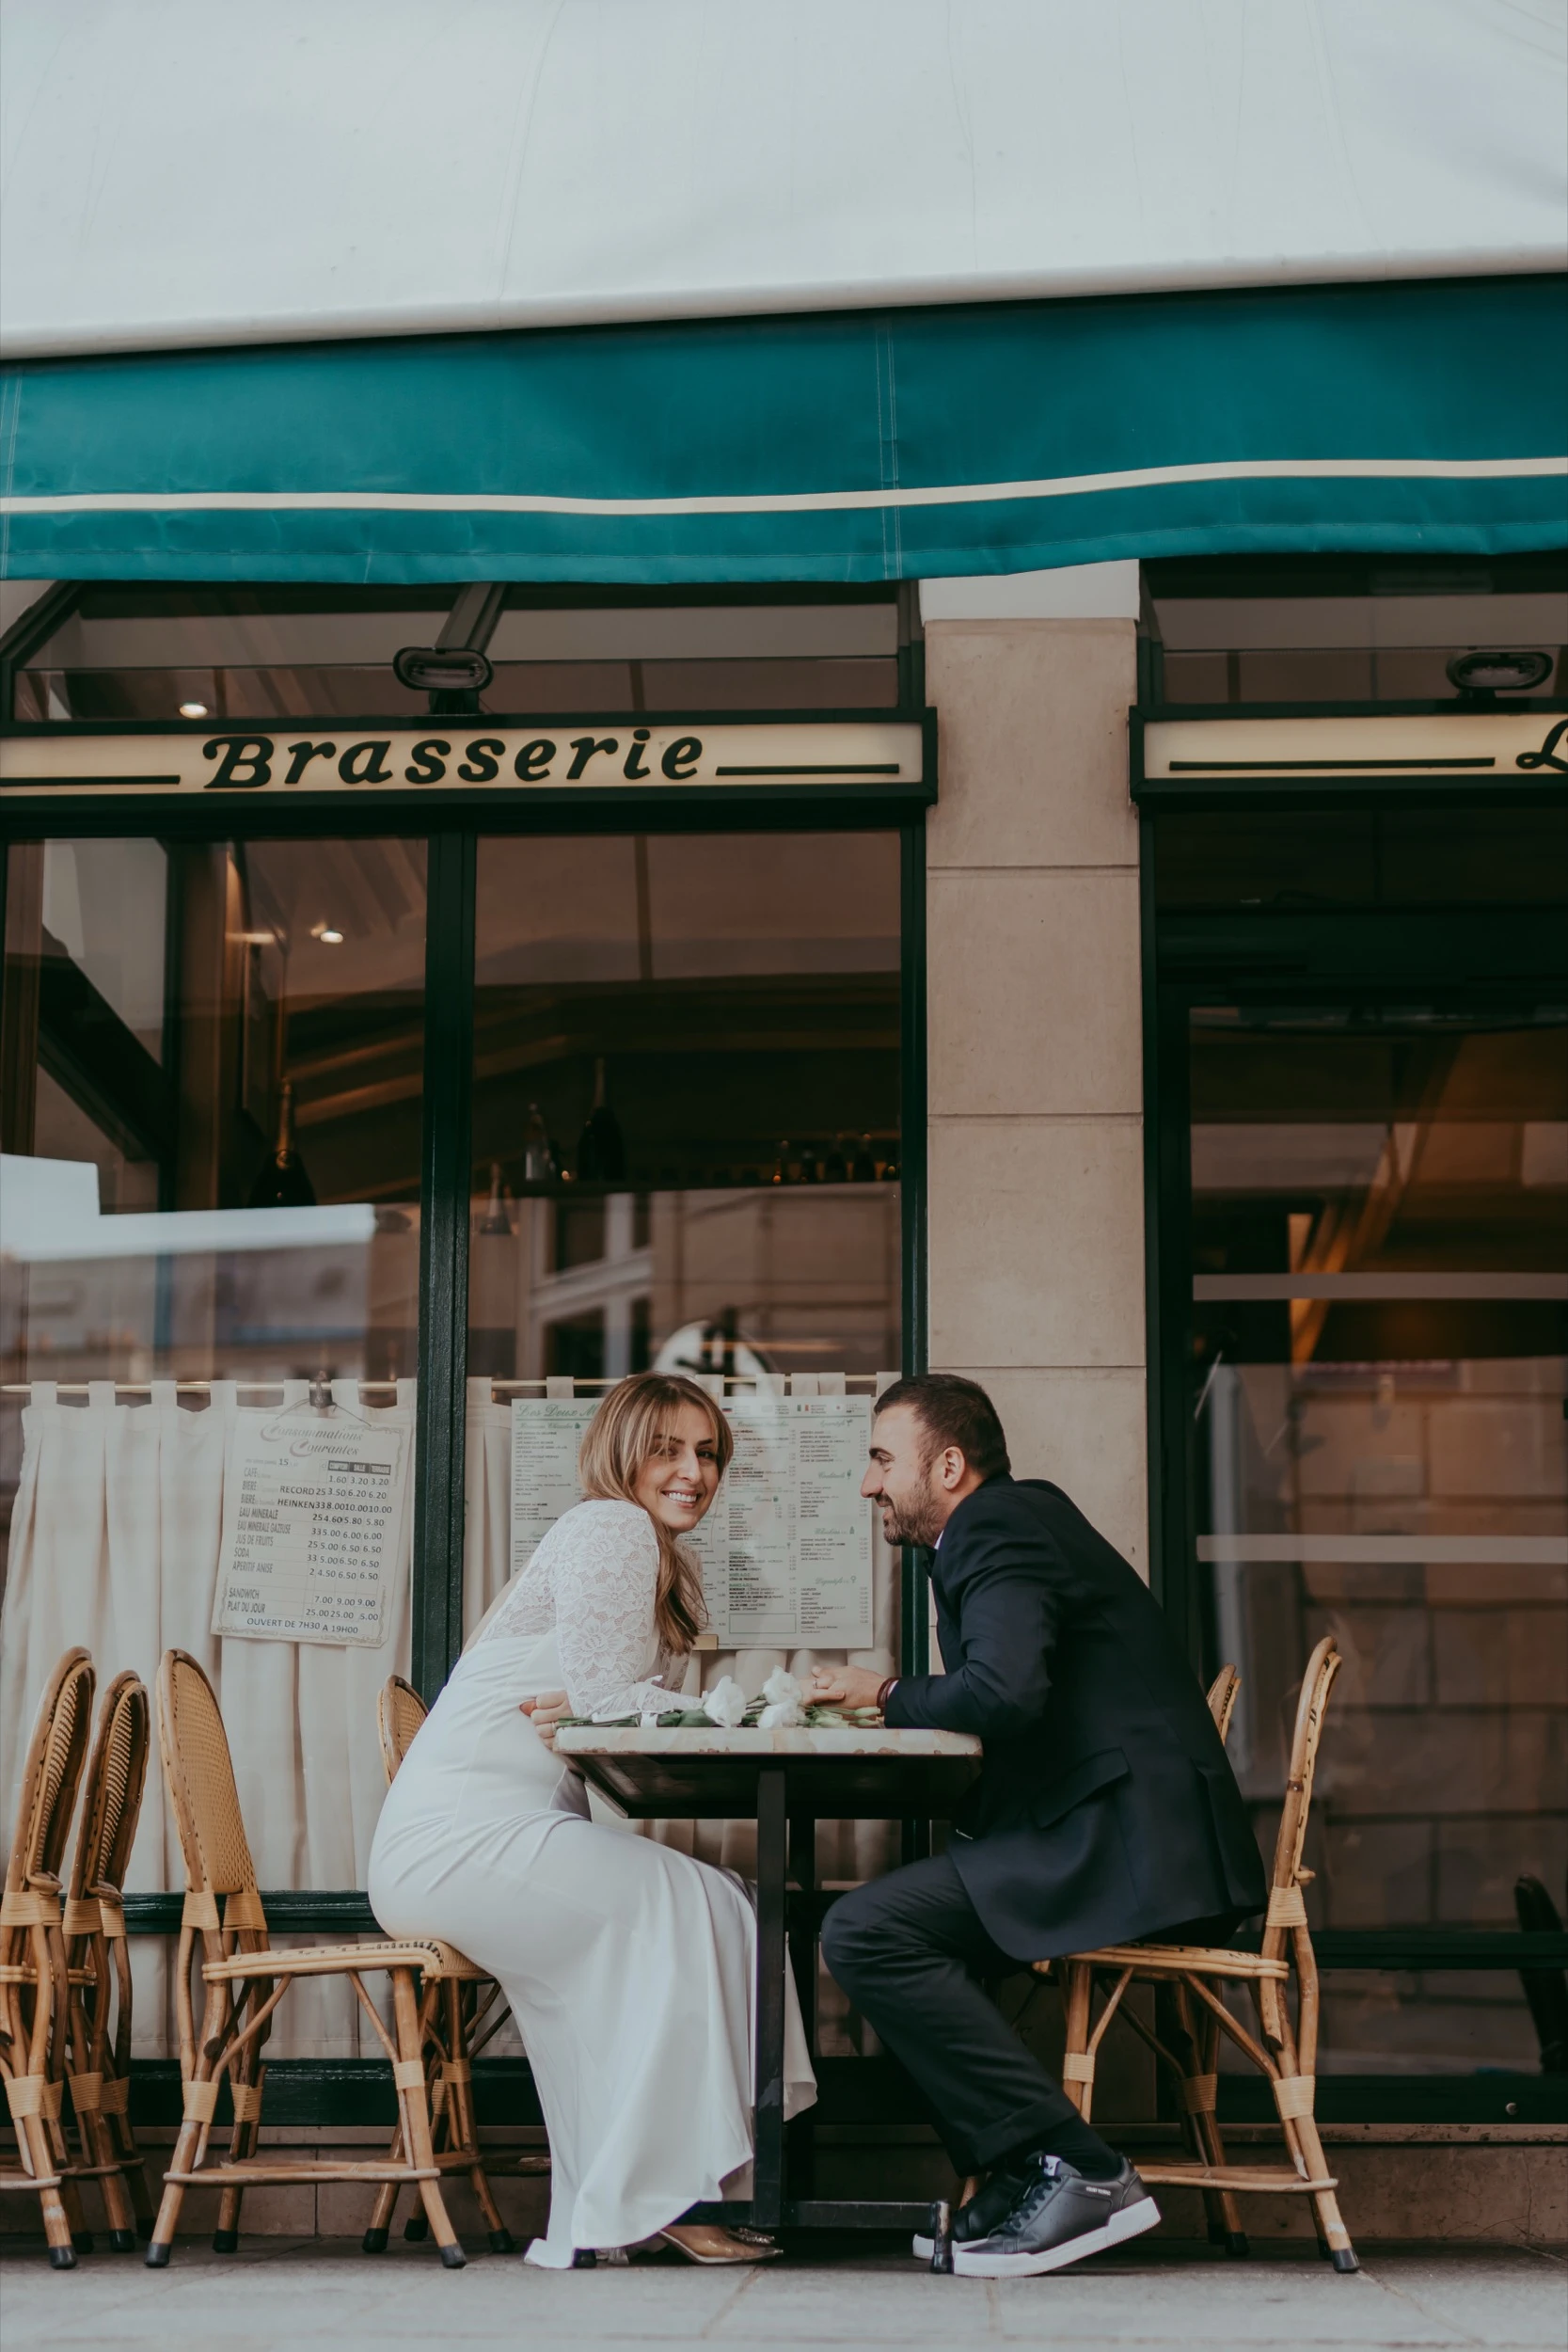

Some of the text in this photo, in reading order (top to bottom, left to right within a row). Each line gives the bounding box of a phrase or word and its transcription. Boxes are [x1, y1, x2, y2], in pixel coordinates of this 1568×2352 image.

[202, 728, 704, 788] Brasserie
[515, 1405, 541, 1417] Les
[543, 1404, 578, 1417] Deux
[260, 1422, 363, 1442] Consommations
[290, 1438, 358, 1457] Courantes
[329, 1475, 346, 1484] 1.60
[279, 1486, 315, 1495] RECORD
[328, 1488, 346, 1497] 3.50
[369, 1491, 387, 1500] 6.20
[239, 1506, 250, 1518] EAU
[251, 1507, 278, 1519] MINERALE
[324, 1515, 342, 1523] 4.60
[343, 1517, 362, 1525] 5.80
[277, 1498, 315, 1509] HEINKEN
[326, 1502, 344, 1510] 8.00
[345, 1503, 368, 1512] 10.00
[369, 1504, 392, 1514] 10.00
[237, 1520, 246, 1531] EAU
[247, 1521, 269, 1533] MINERALE
[270, 1523, 291, 1534] GAZEUSE
[323, 1529, 341, 1537] 5.00
[363, 1532, 382, 1540] 6.00
[235, 1534, 245, 1544] JUS
[247, 1535, 254, 1545] DE
[255, 1535, 273, 1547] FRUITS
[321, 1542, 338, 1550] 5.00
[341, 1544, 359, 1552] 6.50
[363, 1545, 381, 1553] 6.50
[233, 1548, 249, 1558] SODA
[340, 1557, 357, 1565] 6.50
[360, 1559, 379, 1567] 6.50
[232, 1561, 255, 1572] APERITIF
[256, 1563, 273, 1574] ANISE
[317, 1569, 336, 1578] 4.50
[338, 1571, 356, 1580] 6.50
[359, 1572, 378, 1581] 6.50
[229, 1587, 375, 1607] SANDWICH 7.00 9.00 9.00
[228, 1600, 241, 1612] PLAT
[242, 1602, 248, 1613] DU
[250, 1602, 265, 1613] JOUR
[306, 1609, 329, 1617] 25.00
[330, 1611, 354, 1619] 25.00
[246, 1618, 282, 1627] OUVERT
[298, 1621, 320, 1629] 7H30
[331, 1625, 357, 1633] 19H00
